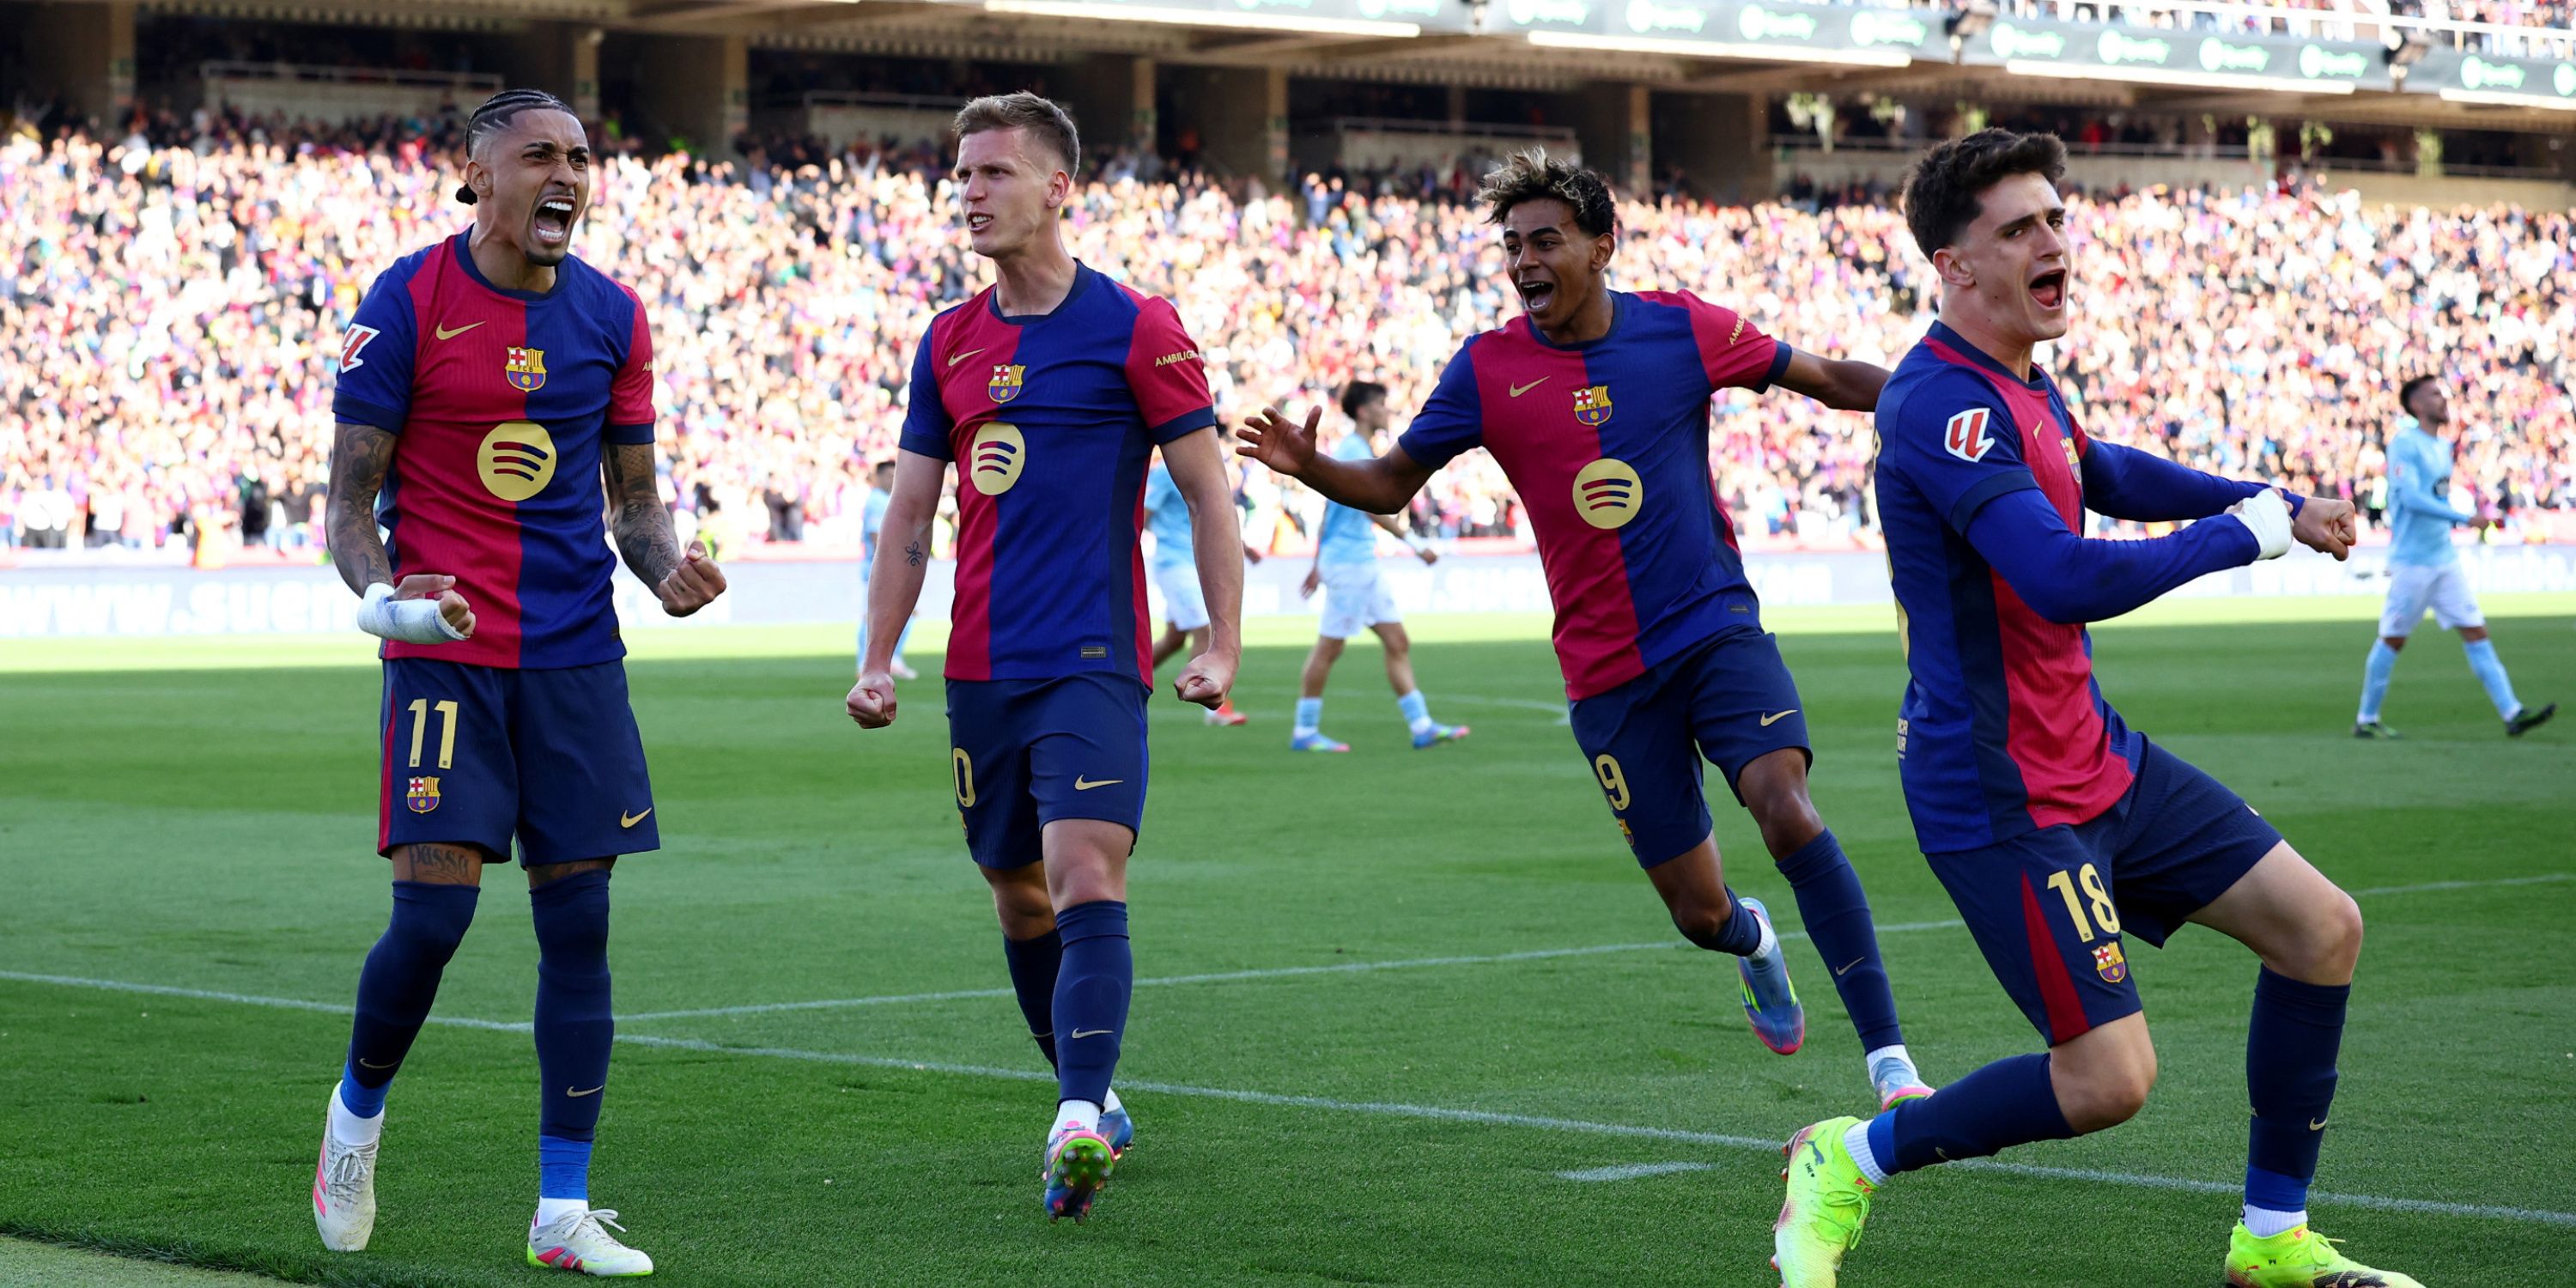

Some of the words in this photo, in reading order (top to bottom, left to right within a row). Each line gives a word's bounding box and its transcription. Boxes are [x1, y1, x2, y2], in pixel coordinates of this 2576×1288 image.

[408, 698, 459, 769] 11
[1595, 754, 1631, 811] 9
[2047, 863, 2121, 943] 18
